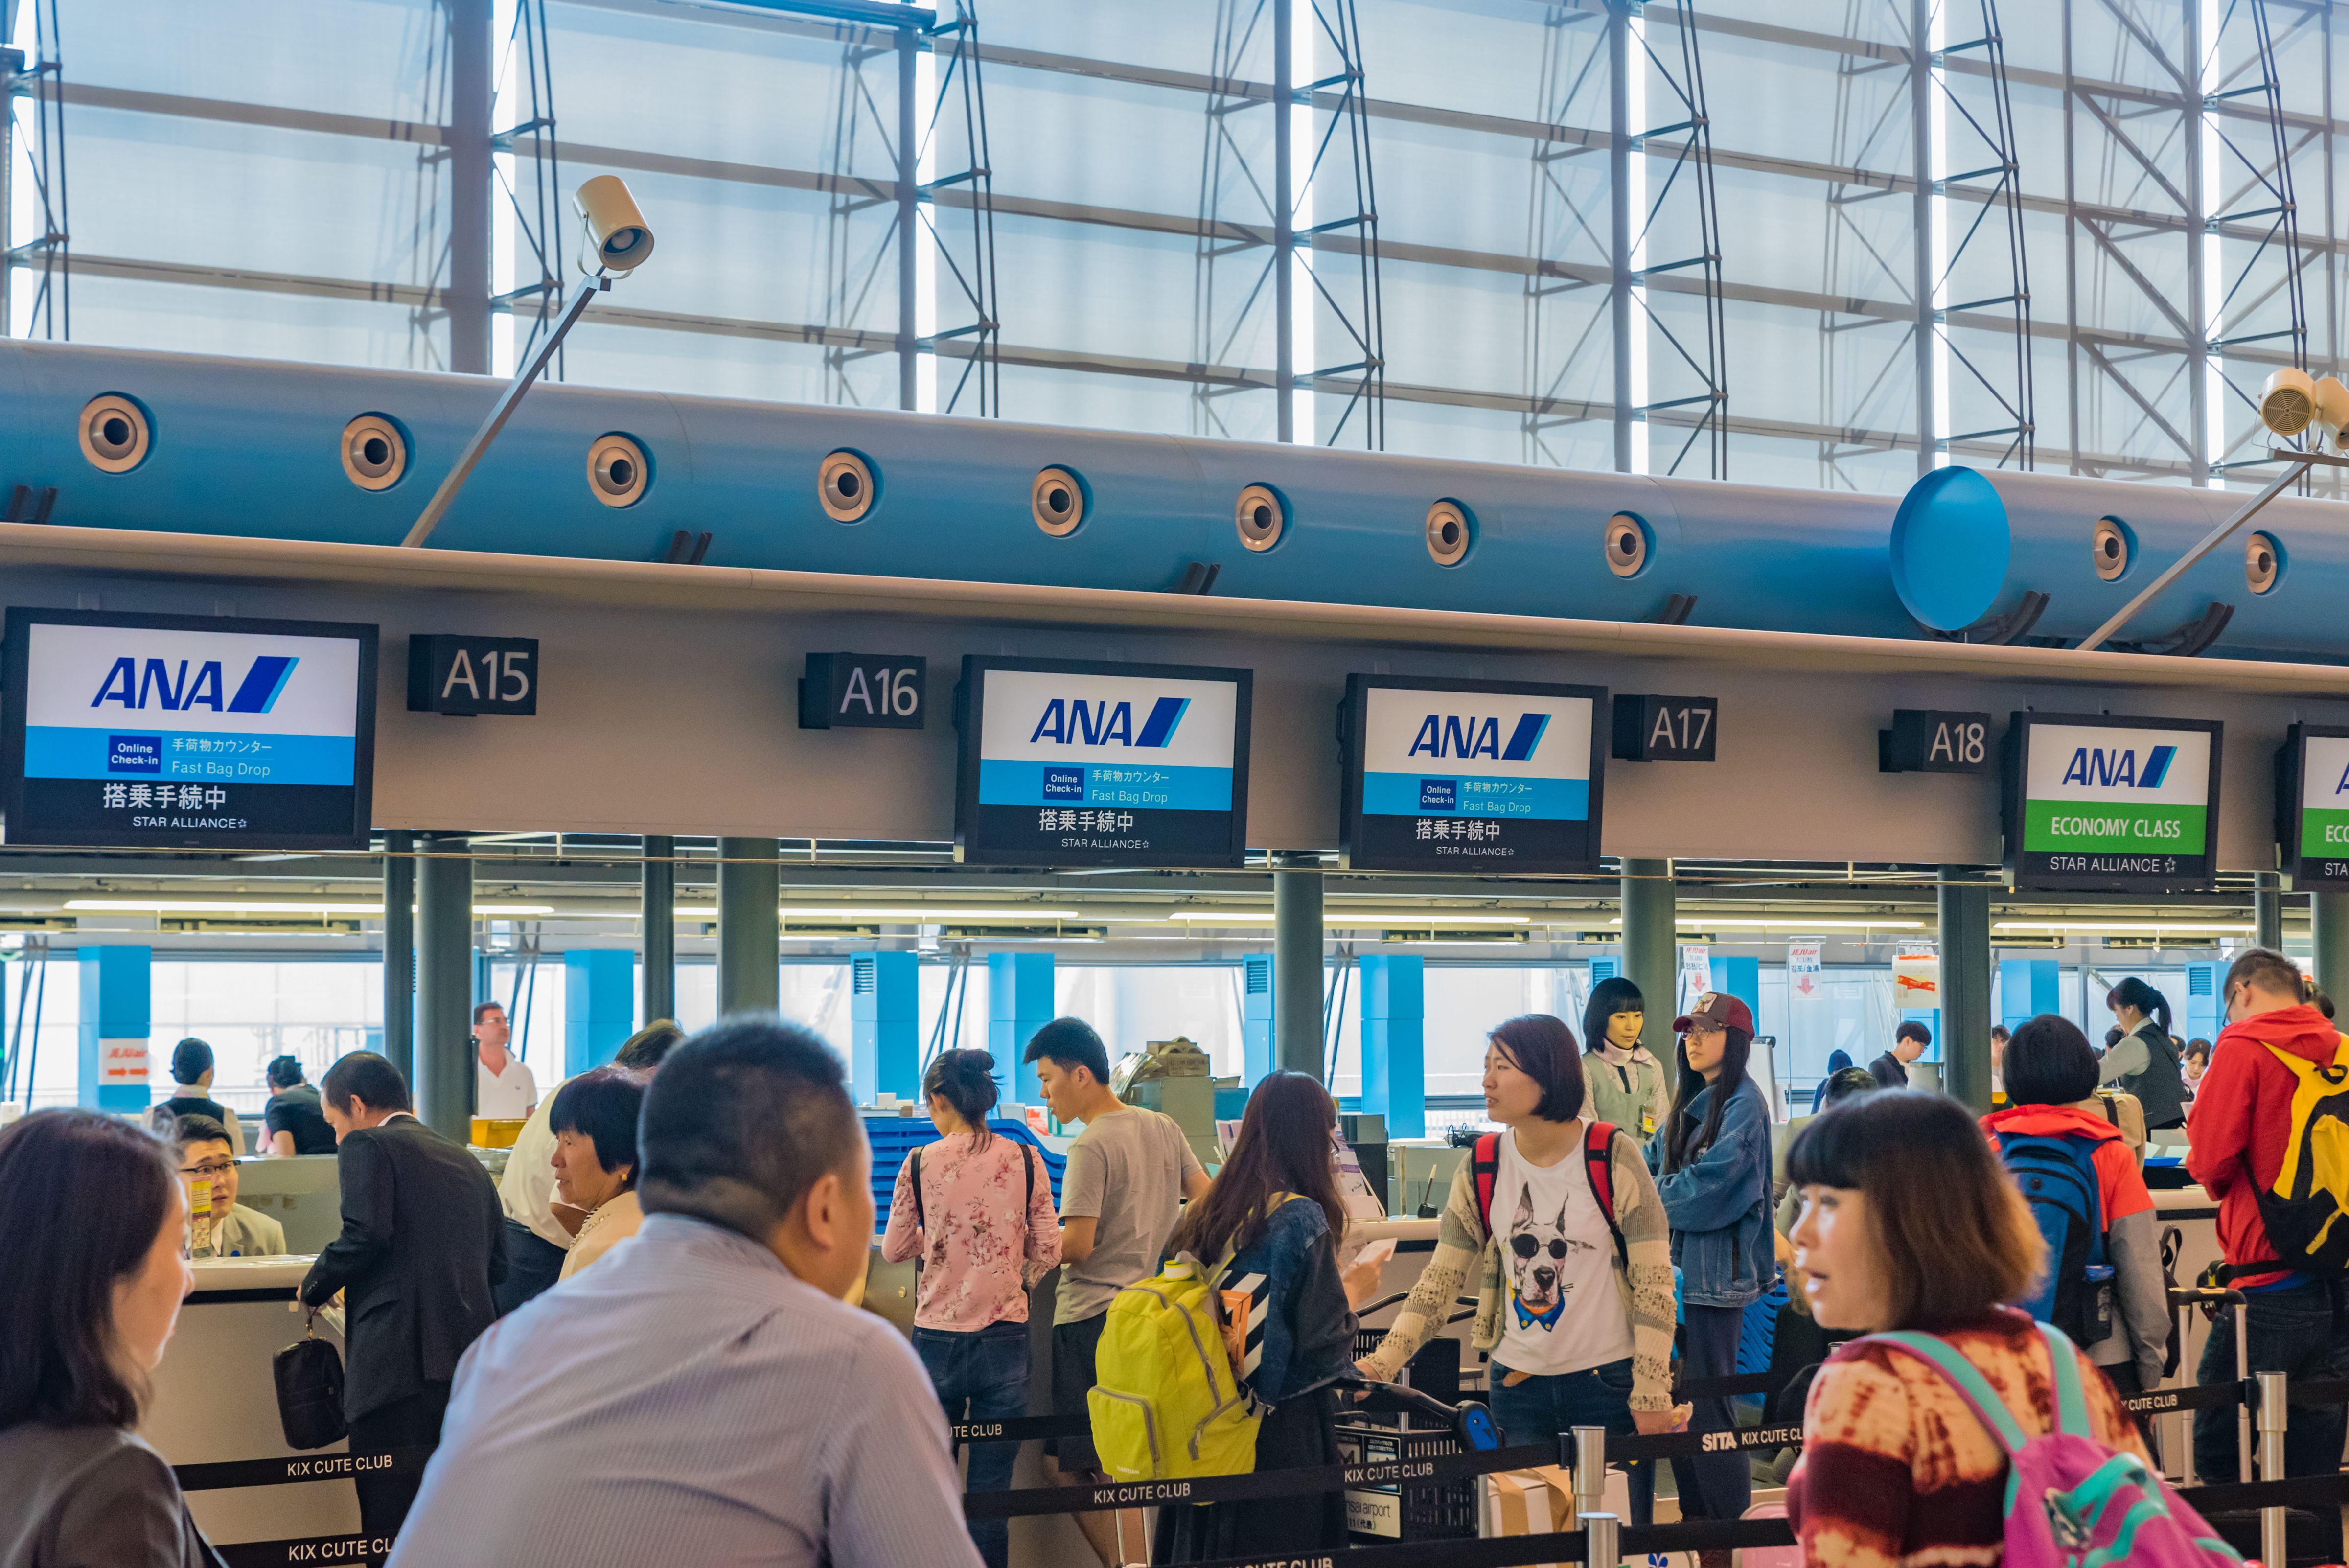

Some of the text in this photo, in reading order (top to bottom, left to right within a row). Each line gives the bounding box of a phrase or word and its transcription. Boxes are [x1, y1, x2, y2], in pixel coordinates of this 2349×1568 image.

[90, 656, 224, 712] ANA
[441, 649, 529, 702] A15
[839, 667, 918, 717] A16
[1030, 698, 1132, 747] ANA
[1649, 707, 1712, 750] A17
[1408, 714, 1499, 760] ANA
[1929, 722, 1985, 763] A18
[118, 743, 153, 754] Online
[172, 738, 272, 754] 手荷物カウンター
[111, 755, 159, 765] Check-in
[2062, 747, 2135, 787] ANA
[172, 761, 271, 778] Fast Bag Drop
[1092, 769, 1169, 783] 手荷物カウンター
[1051, 774, 1078, 783] Online
[103, 783, 226, 810] 搭乗手続中
[1045, 784, 1082, 793] Check-in
[1427, 785, 1451, 794] Online
[1463, 782, 1532, 794] 手荷物カウンター
[1092, 790, 1168, 804] Fast Bag Drop
[1422, 796, 1454, 804] Check-in
[1463, 801, 1531, 814] Fast Bag Drop
[133, 817, 237, 829] STAR ALLIANCE
[1039, 808, 1133, 833] 搭乗手続中
[2051, 817, 2181, 838] ECONOMY CLASS
[1416, 818, 1500, 841] 搭乗手続中
[1061, 838, 1141, 849] STAR ALLIANCE
[1436, 846, 1507, 856] STAR ALLIANCE
[2050, 856, 2160, 872] STAR ALLIANCE
[2325, 863, 2348, 876] STA
[2128, 1397, 2153, 1411] CUTE
[2154, 1394, 2178, 1408] CLUB
[948, 1424, 1002, 1438] UTE CLUB
[1702, 1428, 1803, 1452] SITA KIX CUTE CL
[287, 1455, 393, 1476] KIX CUTE CLUB
[1344, 1463, 1434, 1482] KIX CUTE CLUB
[1094, 1482, 1191, 1504] KIX CUTE CLUB
[1363, 1499, 1391, 1519] airport
[289, 1538, 395, 1561] KIX CUTE CL
